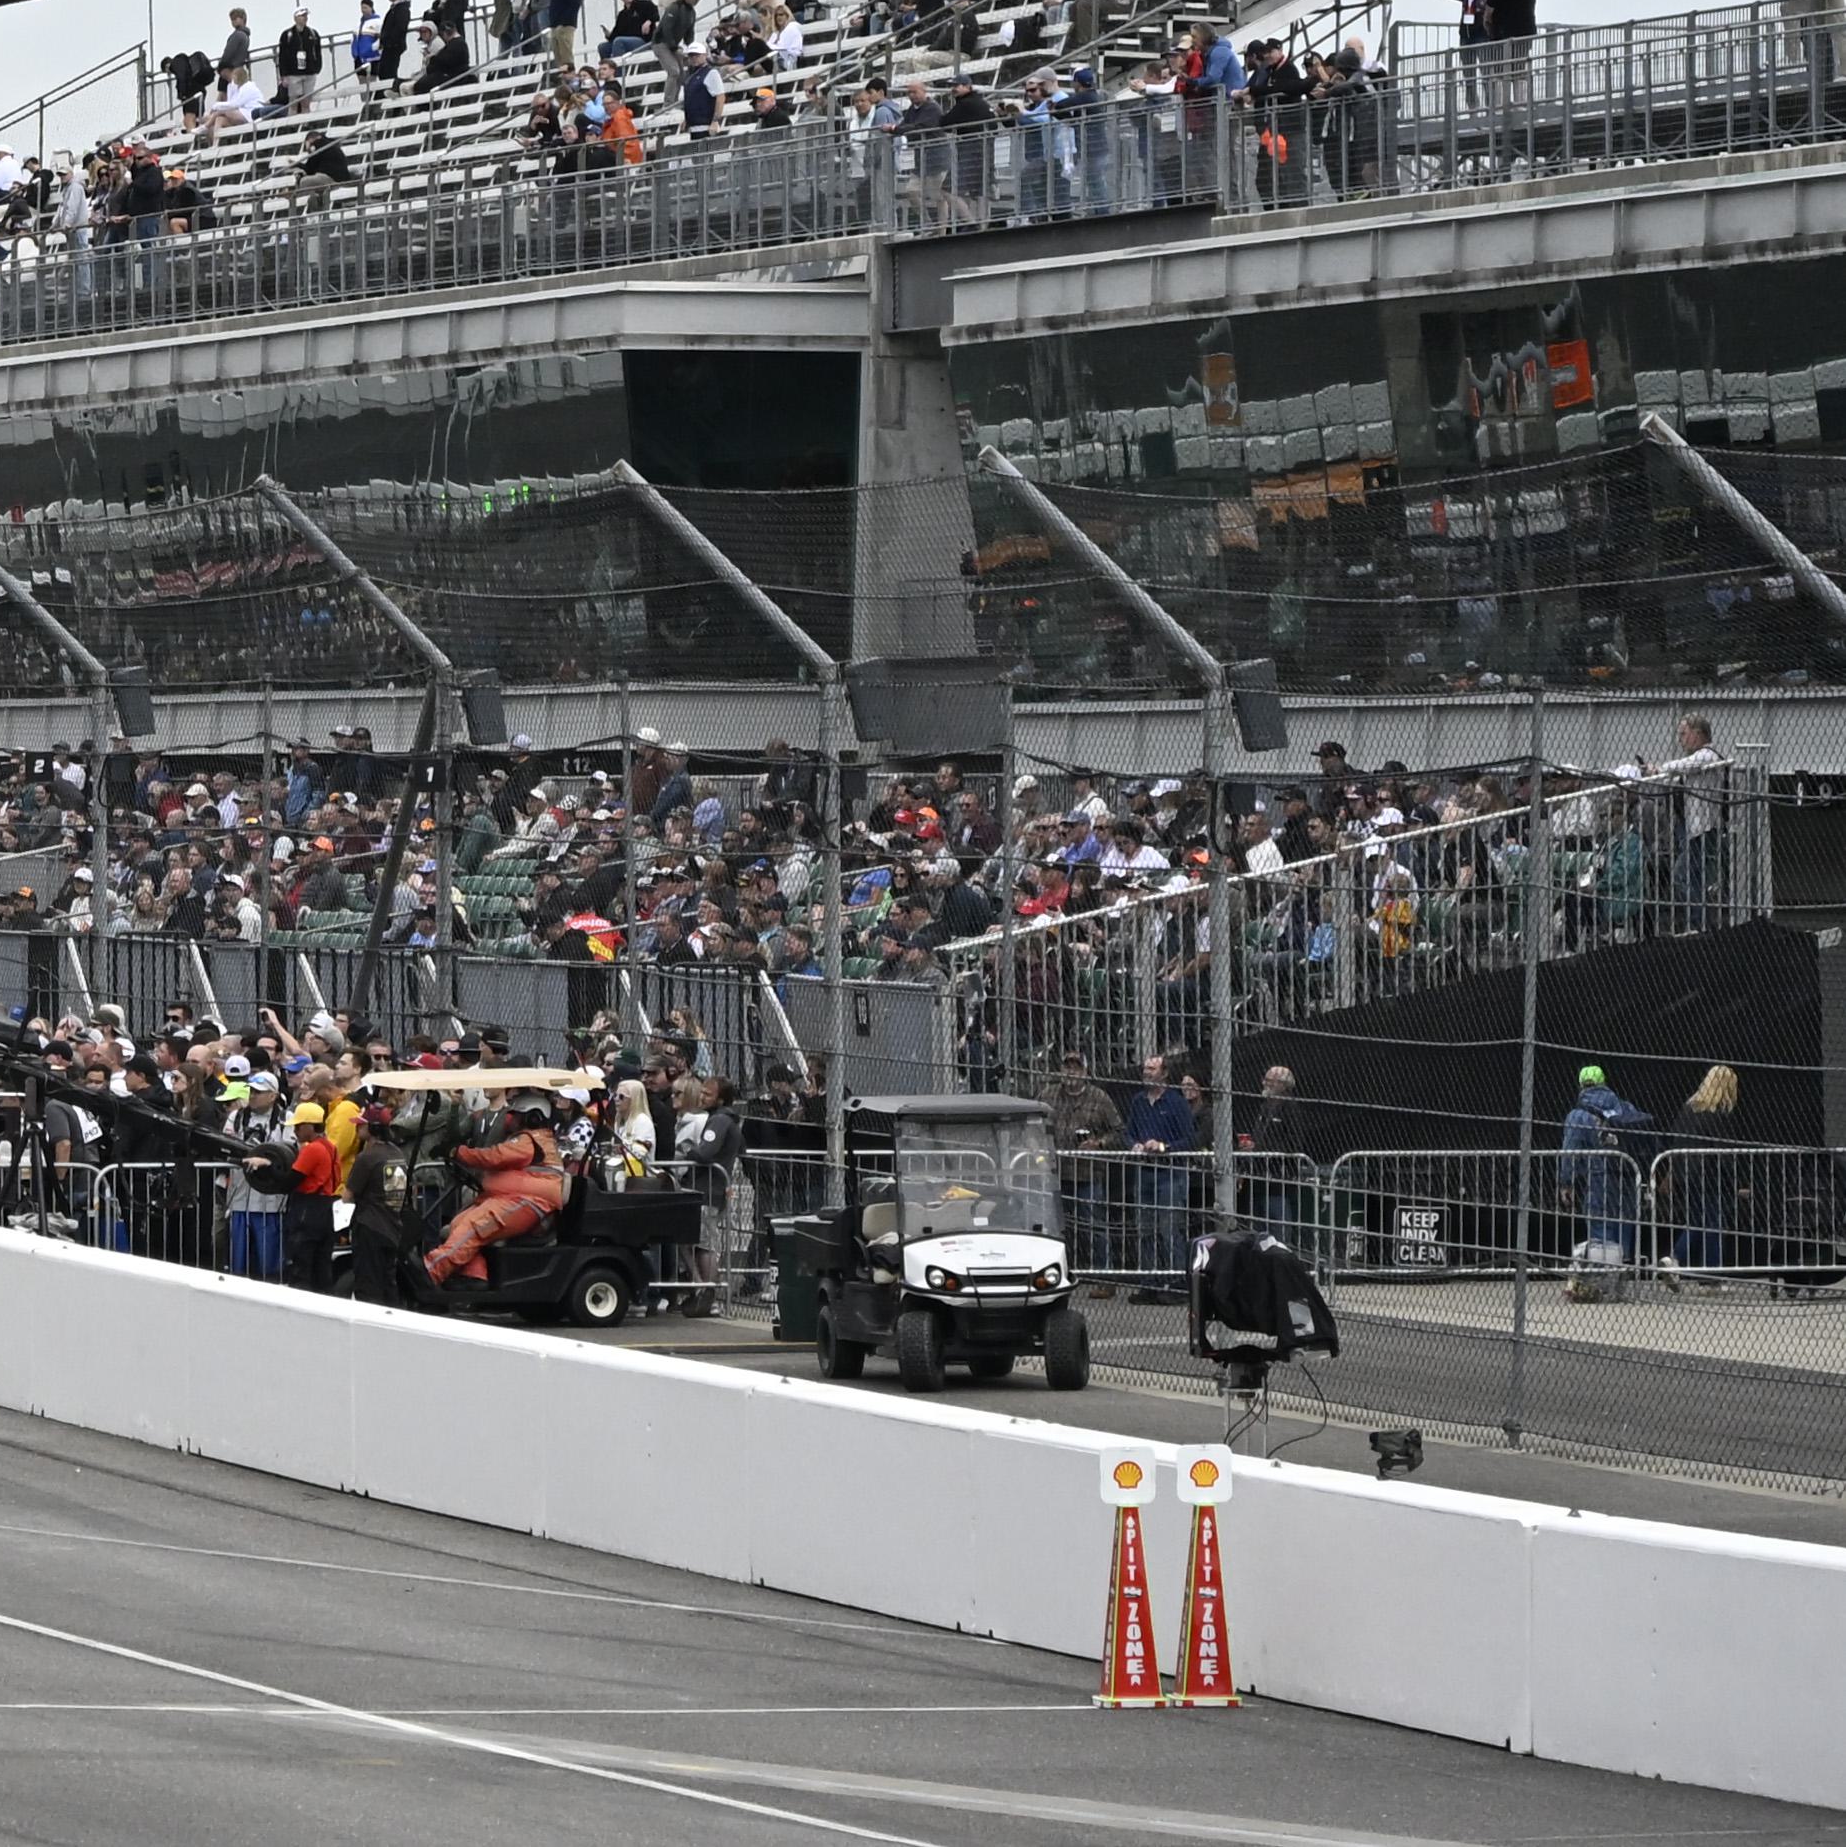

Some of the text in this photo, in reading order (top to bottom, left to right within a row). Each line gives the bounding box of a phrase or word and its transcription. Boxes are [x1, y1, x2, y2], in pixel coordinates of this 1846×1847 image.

[34, 759, 45, 774] 2
[425, 767, 435, 783] 1
[1401, 1211, 1440, 1228] KEEP
[1399, 1245, 1446, 1262] CLEAN
[1126, 1528, 1137, 1581] PIT
[1202, 1528, 1213, 1582] PIT
[1124, 1602, 1146, 1675] ZONE
[1198, 1602, 1220, 1675] ZONE
